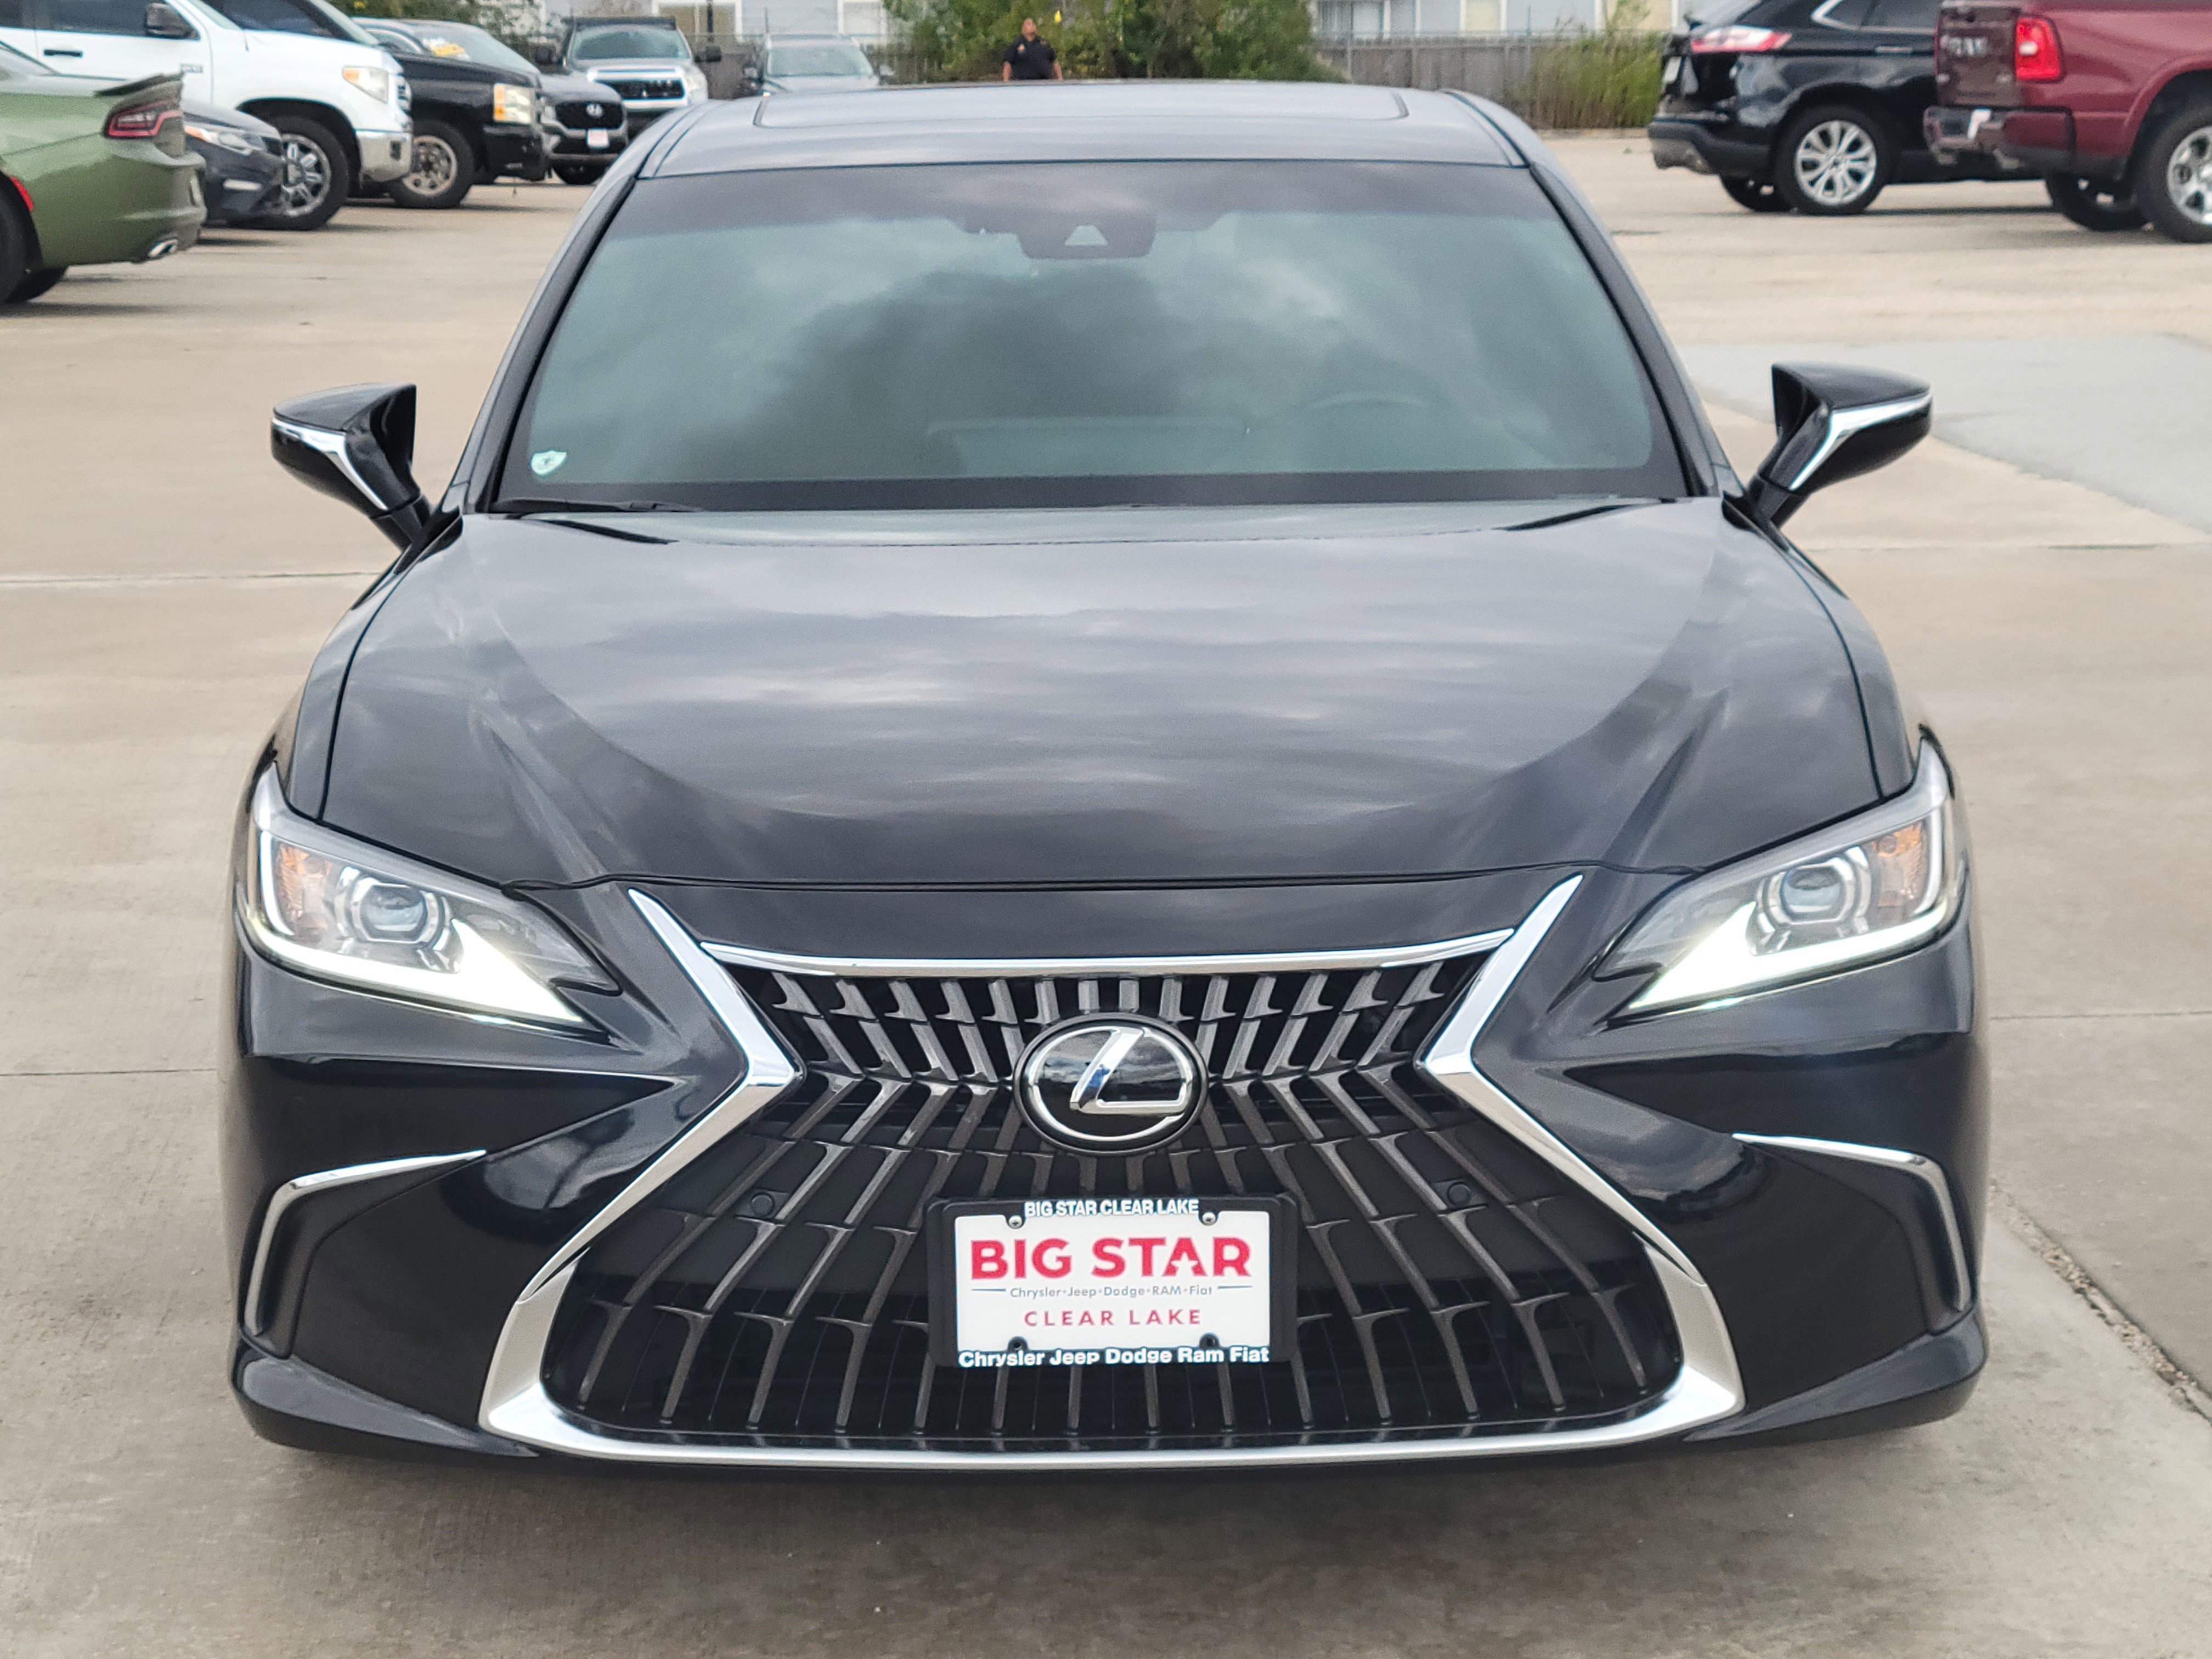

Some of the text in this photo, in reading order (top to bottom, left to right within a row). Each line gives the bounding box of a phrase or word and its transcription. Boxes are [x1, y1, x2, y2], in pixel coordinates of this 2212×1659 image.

[1024, 1199, 1199, 1217] BIG STAR CLEAR LAKE
[970, 1237, 1252, 1279] BIG STAR
[1024, 1309, 1201, 1327] CLEAR LAKE
[958, 1346, 1269, 1368] Chrysler Jeep Dodge Ram Fiat
